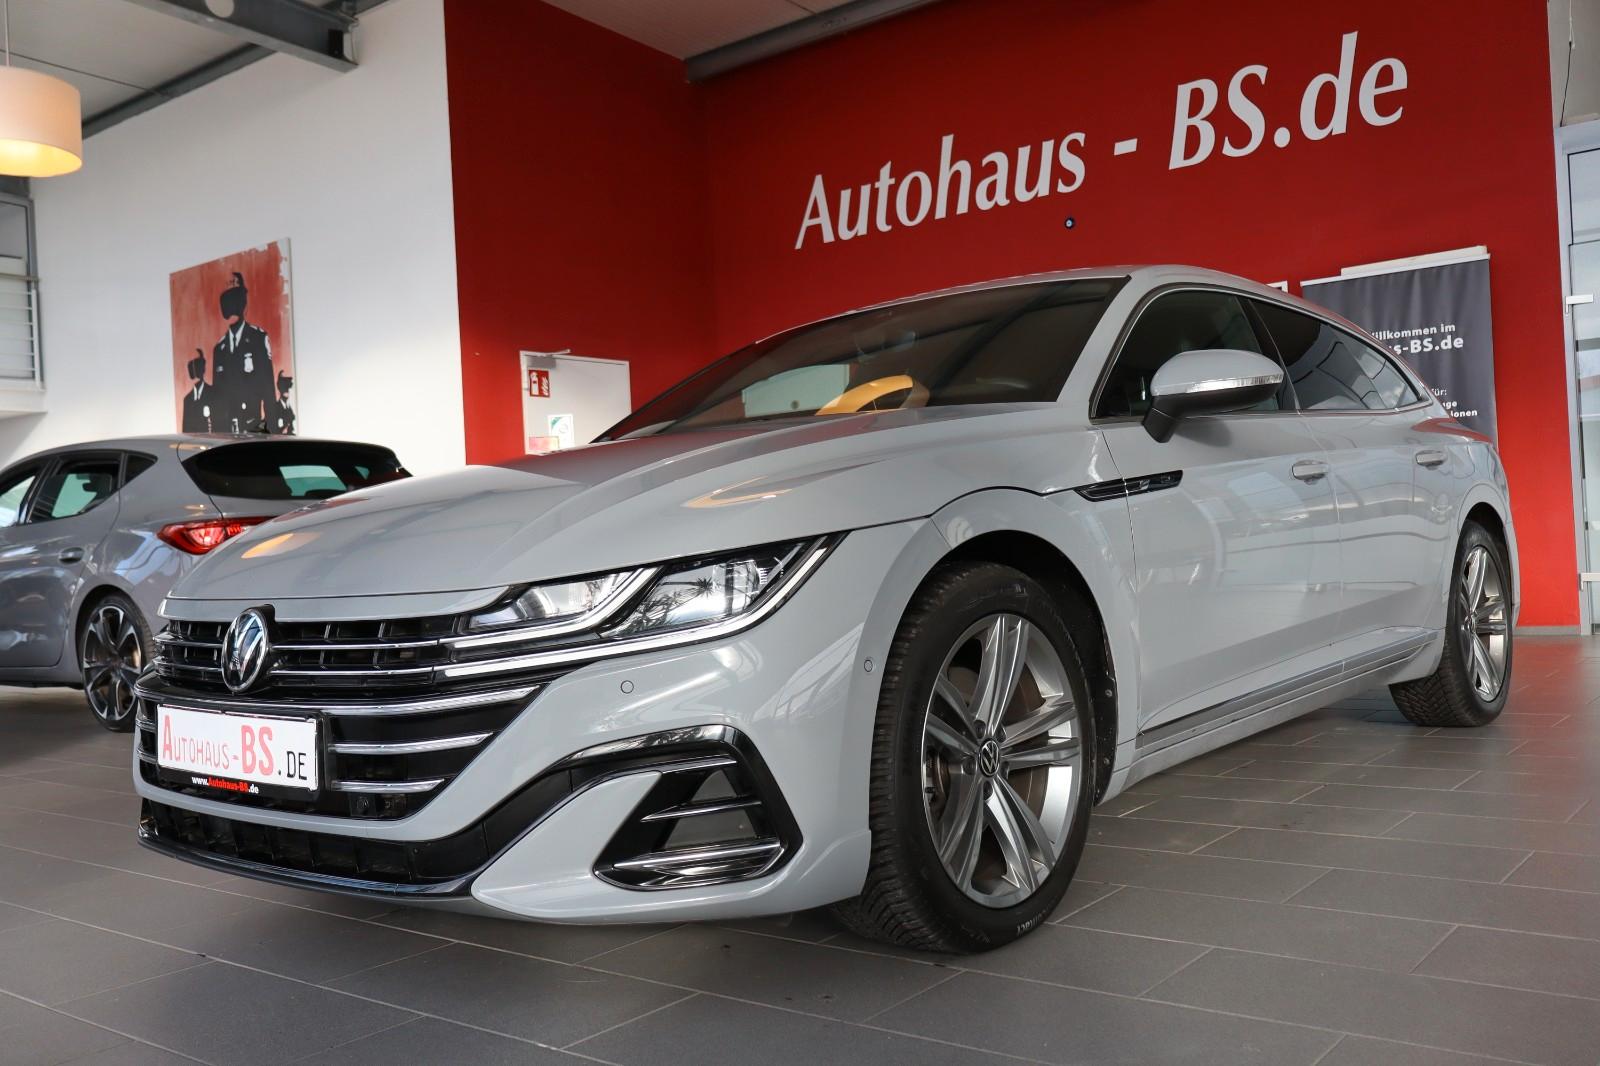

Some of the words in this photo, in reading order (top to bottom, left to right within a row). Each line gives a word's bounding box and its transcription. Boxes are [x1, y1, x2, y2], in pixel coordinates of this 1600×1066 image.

[795, 132, 1087, 250] Autohaus
[1114, 138, 1139, 156] -
[1168, 31, 1409, 170] BS.de
[1372, 325, 1437, 341] illkommen
[1440, 323, 1456, 333] im
[1389, 335, 1464, 355] s-BS.de
[191, 776, 260, 795] www.Autohaus-BS.de
